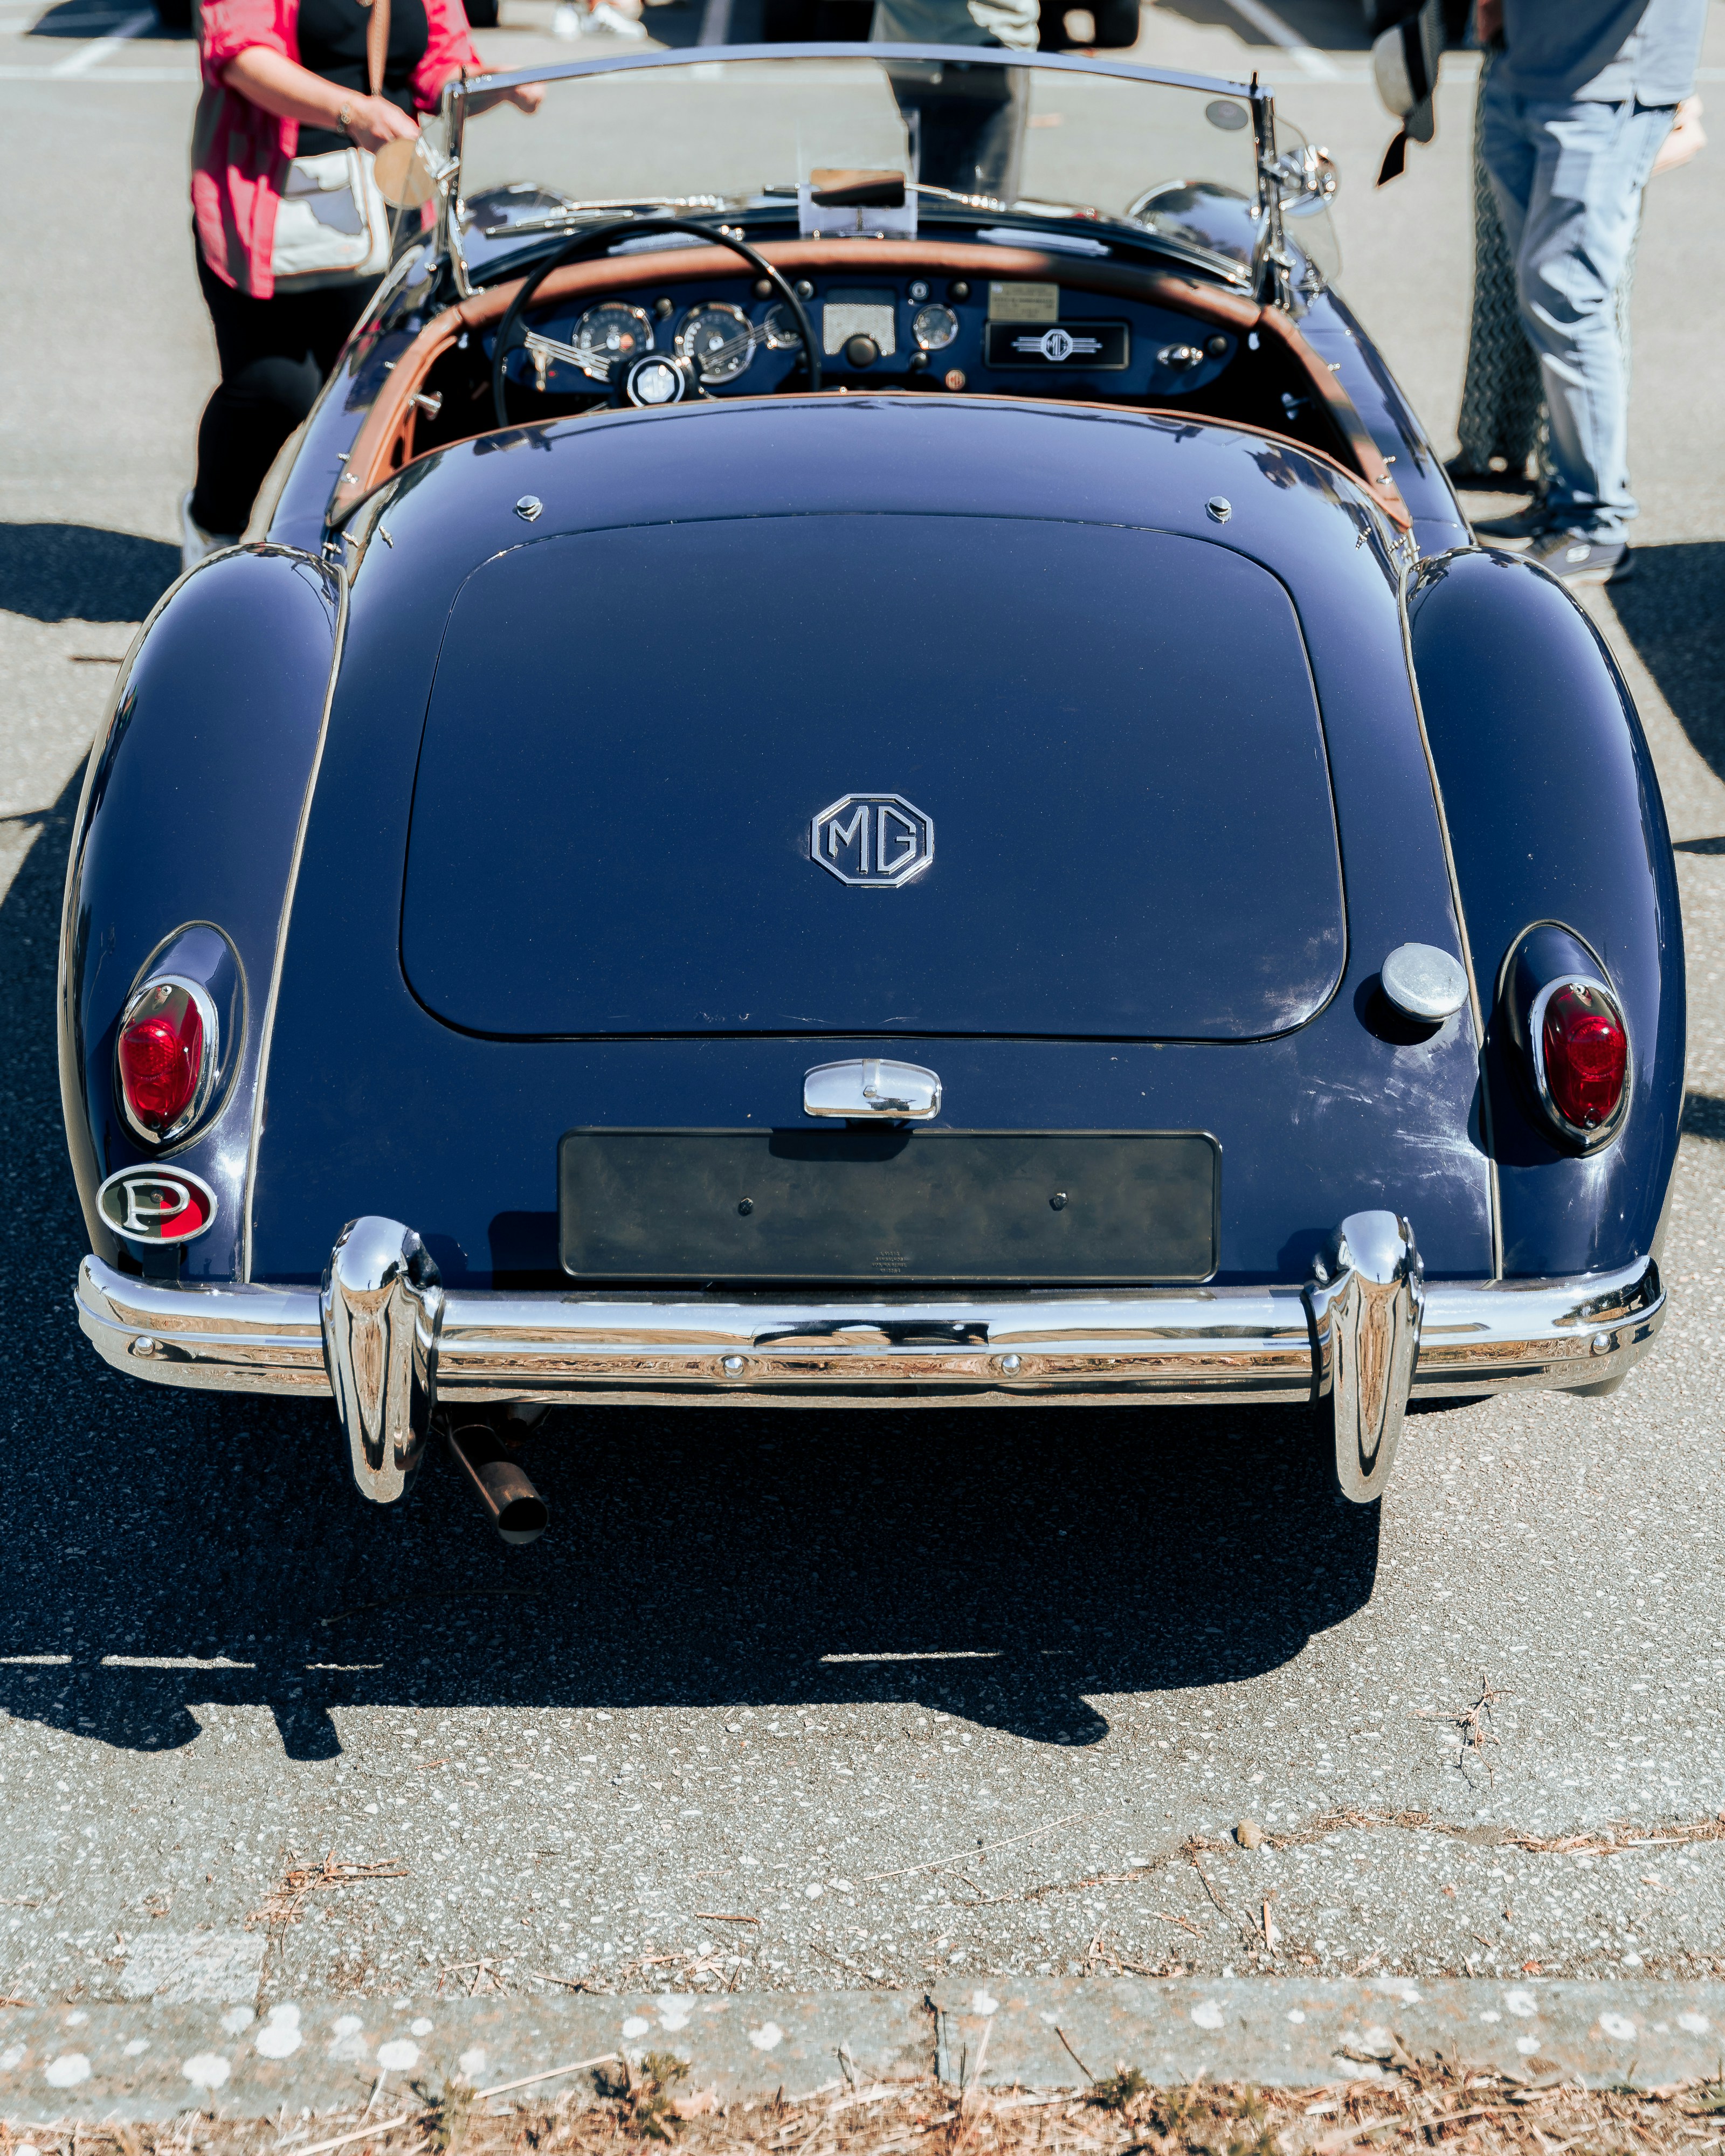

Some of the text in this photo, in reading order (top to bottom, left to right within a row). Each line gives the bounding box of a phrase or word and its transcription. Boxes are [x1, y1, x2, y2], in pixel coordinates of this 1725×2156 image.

[1045, 333, 1068, 357] MG
[827, 805, 916, 874] MG
[123, 1178, 190, 1231] P
